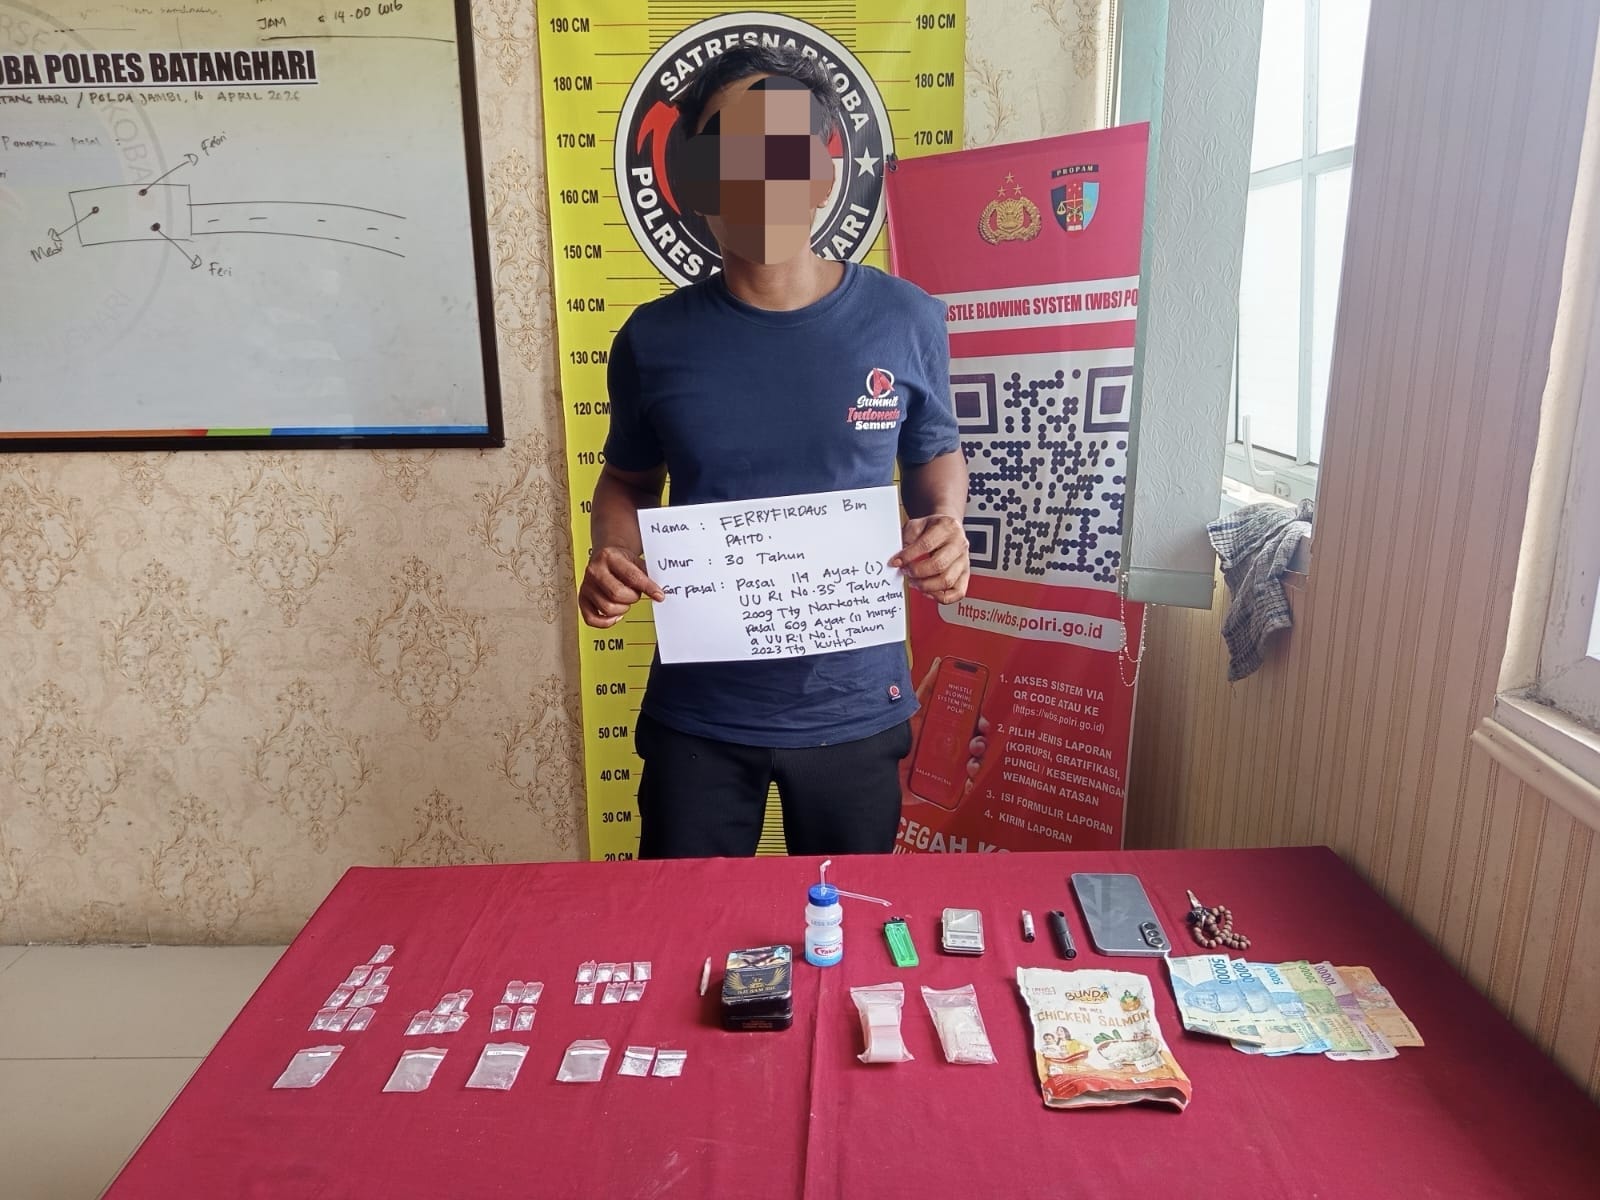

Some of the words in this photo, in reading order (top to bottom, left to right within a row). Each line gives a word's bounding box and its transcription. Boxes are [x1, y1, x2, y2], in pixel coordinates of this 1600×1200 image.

[256, 17, 287, 30] JAM
[550, 18, 569, 33] 190
[572, 17, 590, 33] CM
[915, 14, 934, 30] 190
[937, 14, 956, 29] CM
[0, 54, 42, 85] BA
[44, 53, 145, 83] POLRES
[149, 50, 316, 82] BATANGHARI
[553, 76, 572, 92] 180
[575, 76, 593, 91] CM
[914, 73, 933, 89] 180
[937, 72, 955, 88] CM
[217, 90, 263, 102] APRIL
[556, 133, 575, 149] 170
[578, 133, 596, 148] CM
[914, 130, 932, 146] 170
[935, 130, 954, 145] CM
[1056, 165, 1094, 176] PROPAM
[559, 190, 579, 205] 160
[581, 190, 599, 204] CM
[631, 166, 704, 276] POLRES
[563, 245, 582, 260] 150
[584, 245, 602, 259] CM
[566, 299, 585, 313] 140
[588, 298, 605, 312] CM
[977, 299, 1030, 320] BLOWING
[1033, 294, 1081, 315] SYSTEM
[1085, 291, 1122, 311] (WBS)
[570, 352, 588, 365] 130
[591, 351, 608, 364] CM
[573, 402, 591, 415] 120
[594, 401, 611, 414] CM
[577, 452, 595, 464] 110
[580, 501, 592, 513] 10
[651, 523, 689, 534] Nama
[725, 554, 744, 565] 30
[756, 551, 806, 564] Tahun
[739, 595, 761, 607] UU
[846, 579, 891, 593] Tahun
[957, 602, 1104, 640] https://wbs.polri.go.id
[765, 636, 783, 645] UU
[845, 623, 885, 637] Tahun
[593, 639, 607, 651] 70
[608, 638, 624, 650] CM
[751, 645, 782, 656] 2023
[596, 683, 609, 695] 60
[610, 683, 627, 695] CM
[1014, 675, 1049, 689] AKSES
[1050, 680, 1083, 697] SISTEM
[1086, 688, 1105, 702] VIA
[1014, 689, 1028, 701] QR
[1030, 692, 1057, 707] CODE
[1058, 699, 1082, 714] ATAU
[1084, 704, 1100, 717] KE
[598, 727, 611, 739] 50
[612, 726, 628, 739] CM
[1008, 726, 1036, 740] PILIH
[1037, 731, 1063, 748] JENIS
[1065, 739, 1113, 761] LAPORAN
[1004, 756, 1041, 773] PUNGLI
[1006, 741, 1053, 761] (KORUPSI,
[1055, 753, 1121, 782] GRATIFIKASI,
[600, 769, 613, 781] 40
[614, 769, 630, 781] CM
[1003, 771, 1057, 794] WENANGAN
[1058, 787, 1100, 807] ATASAN
[602, 811, 615, 823] 30
[616, 811, 632, 822] CM
[1001, 792, 1015, 804] ISI
[1016, 796, 1064, 820] FORMULIR
[1066, 812, 1114, 836] LAPORAN
[999, 812, 1026, 829] KIRIM
[1027, 821, 1073, 845] LAPORAN
[604, 853, 617, 861] 20
[617, 853, 633, 861] CM
[1065, 990, 1109, 1000] BUNDA
[1037, 1009, 1092, 1025] CHICKEN
[1098, 1010, 1151, 1028] SALMON
